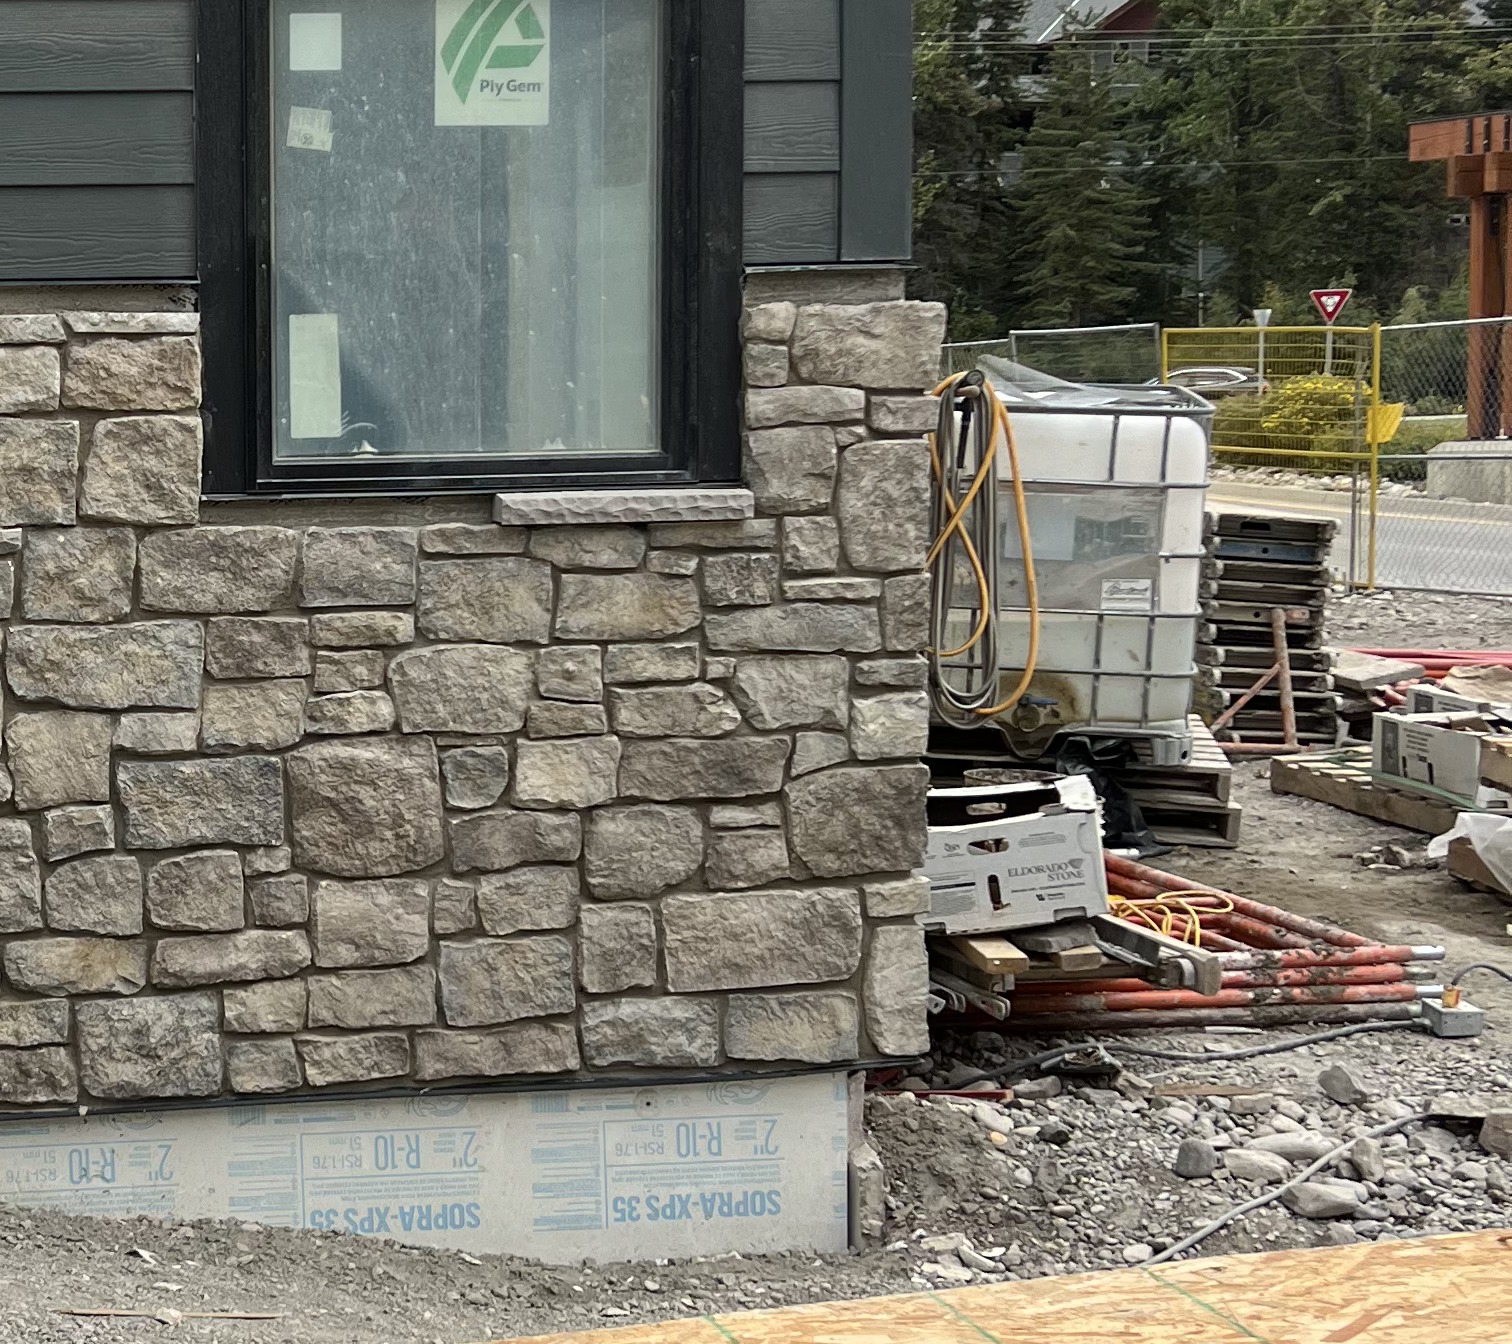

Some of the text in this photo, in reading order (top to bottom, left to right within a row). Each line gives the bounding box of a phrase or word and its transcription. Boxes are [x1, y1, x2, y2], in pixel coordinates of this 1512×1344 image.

[480, 79, 541, 97] Ply Gem
[1008, 861, 1069, 878] ELDORADO
[1048, 870, 1084, 882] STONE
[374, 1134, 420, 1171] R-10
[675, 1121, 722, 1159] R-10
[69, 1148, 116, 1185] R-10
[310, 1202, 481, 1235] SOPRA-XPS 35
[612, 1189, 781, 1223] SOPRA-XPS 35
